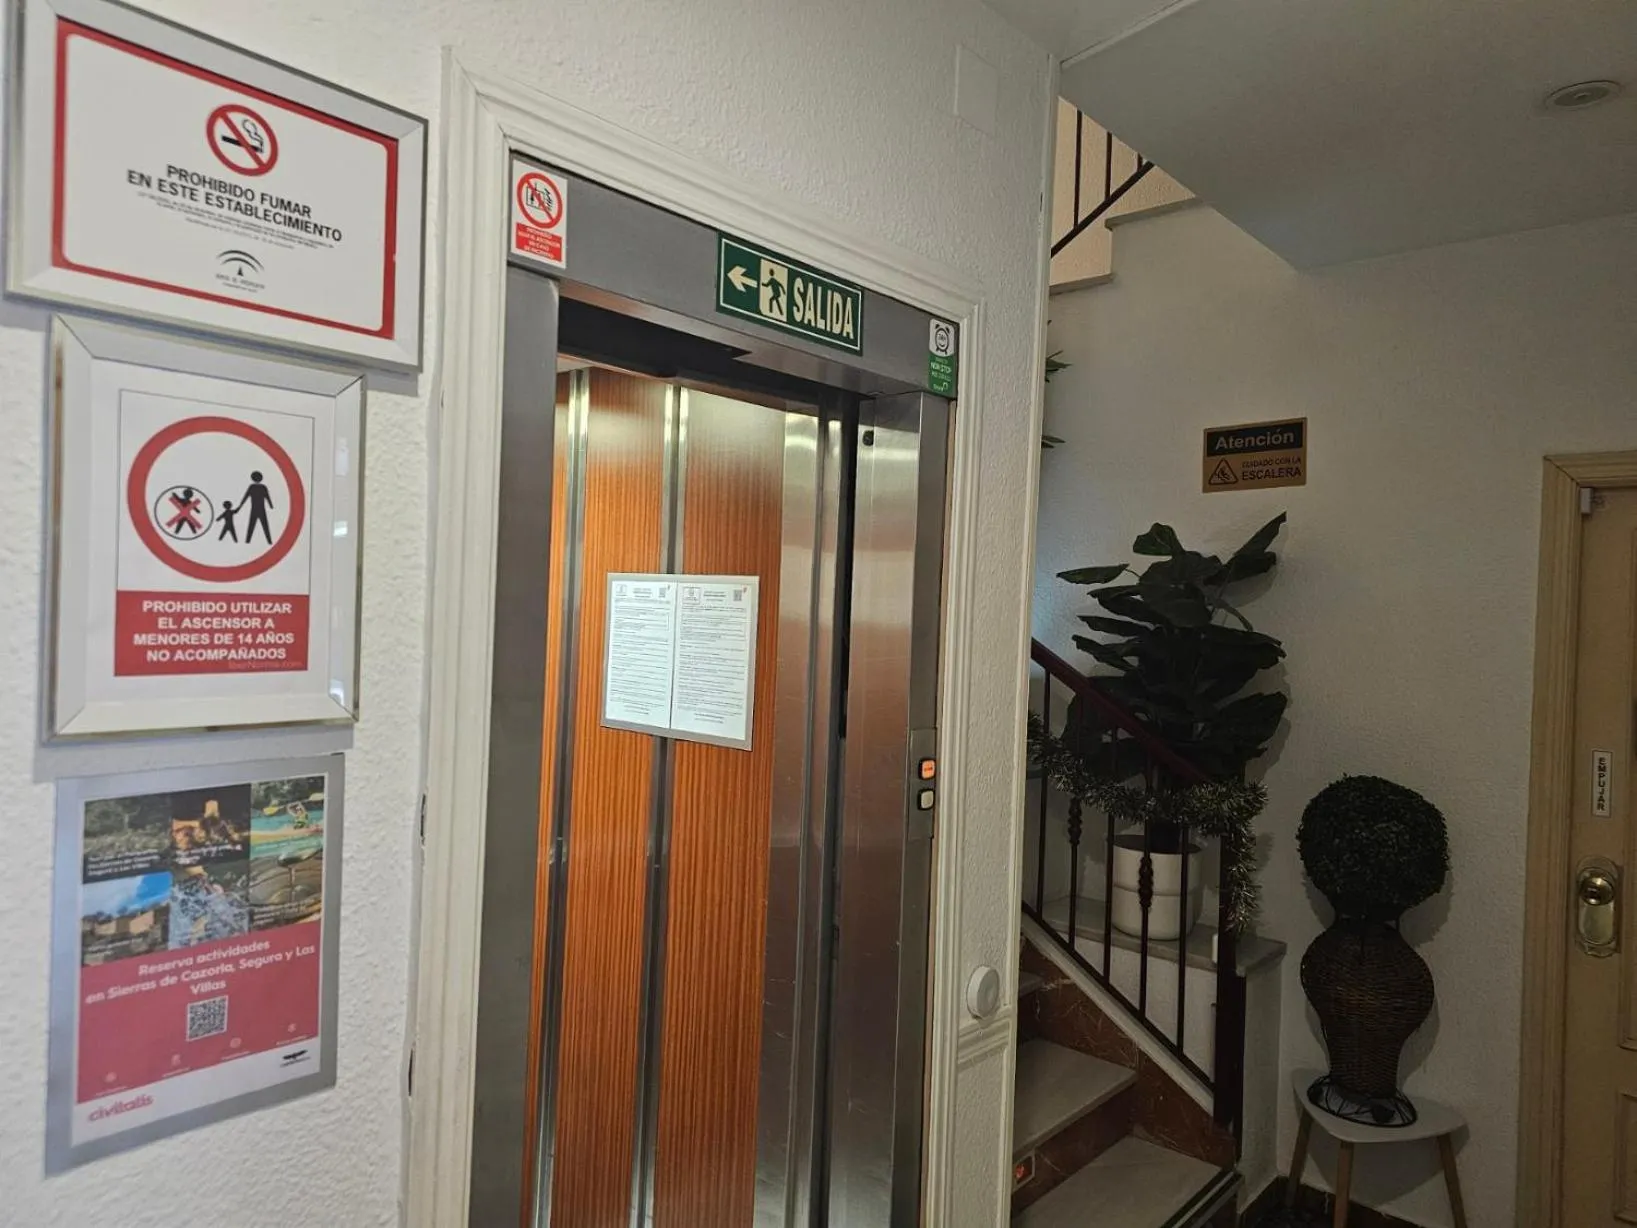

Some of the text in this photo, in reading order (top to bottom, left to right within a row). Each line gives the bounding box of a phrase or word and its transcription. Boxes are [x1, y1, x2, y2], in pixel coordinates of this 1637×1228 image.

[167, 164, 312, 219] PROHIBIDO FUMAR
[127, 169, 343, 242] EN ESTE ESTABLECIMIENTO
[793, 276, 855, 340] SALIDA
[1215, 428, 1294, 450] Atención
[1241, 467, 1302, 481] ESCALERA
[142, 600, 293, 614] PROHIBIDO UTILIZAR
[158, 617, 275, 629] EL ASCENSOR A
[133, 630, 294, 645] MENORES DE 14 AÑOS
[146, 647, 286, 662] NO ACOMPAÑADOS
[1597, 757, 1606, 811] EMPUJAR
[138, 941, 270, 976] Reserva actividades
[85, 944, 315, 1004] en Sierras de Cazorla, Segura y Las
[190, 980, 227, 995] Villas
[88, 1094, 154, 1122] civitatis
